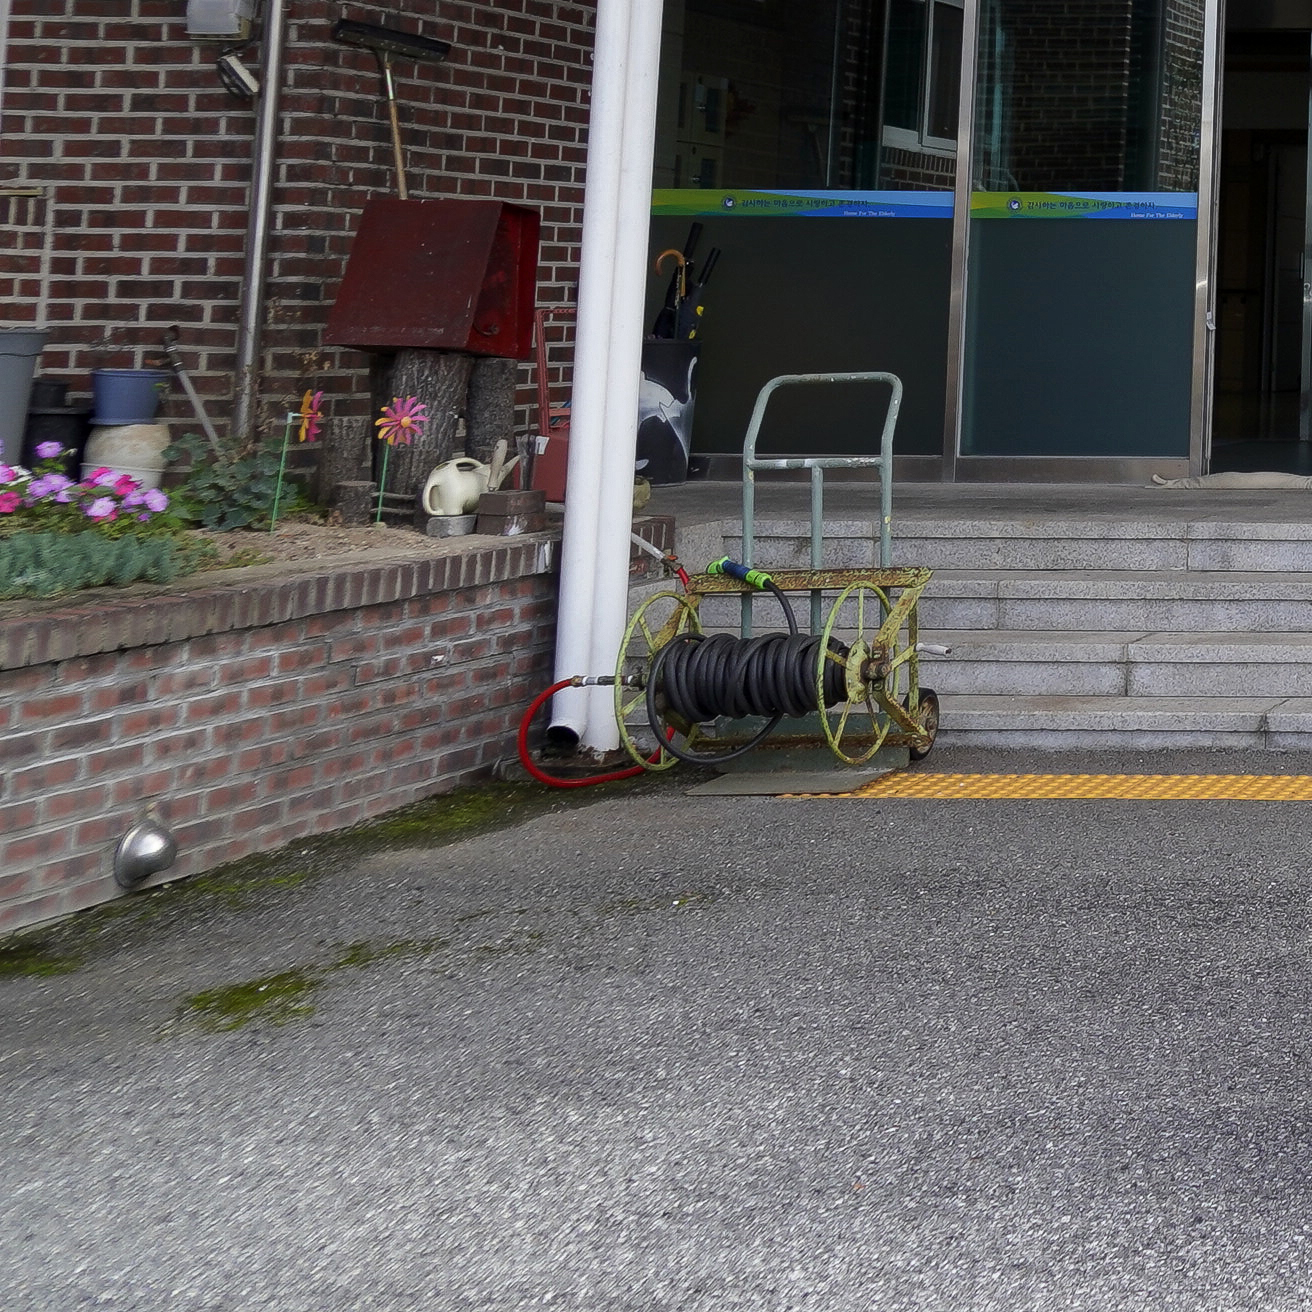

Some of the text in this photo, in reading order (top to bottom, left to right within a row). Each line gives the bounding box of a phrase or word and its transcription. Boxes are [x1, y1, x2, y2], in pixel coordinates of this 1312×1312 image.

[1027, 202, 1057, 210] 감사하는
[1059, 202, 1090, 210] 마음으로
[1092, 201, 1123, 210] 사랑하고
